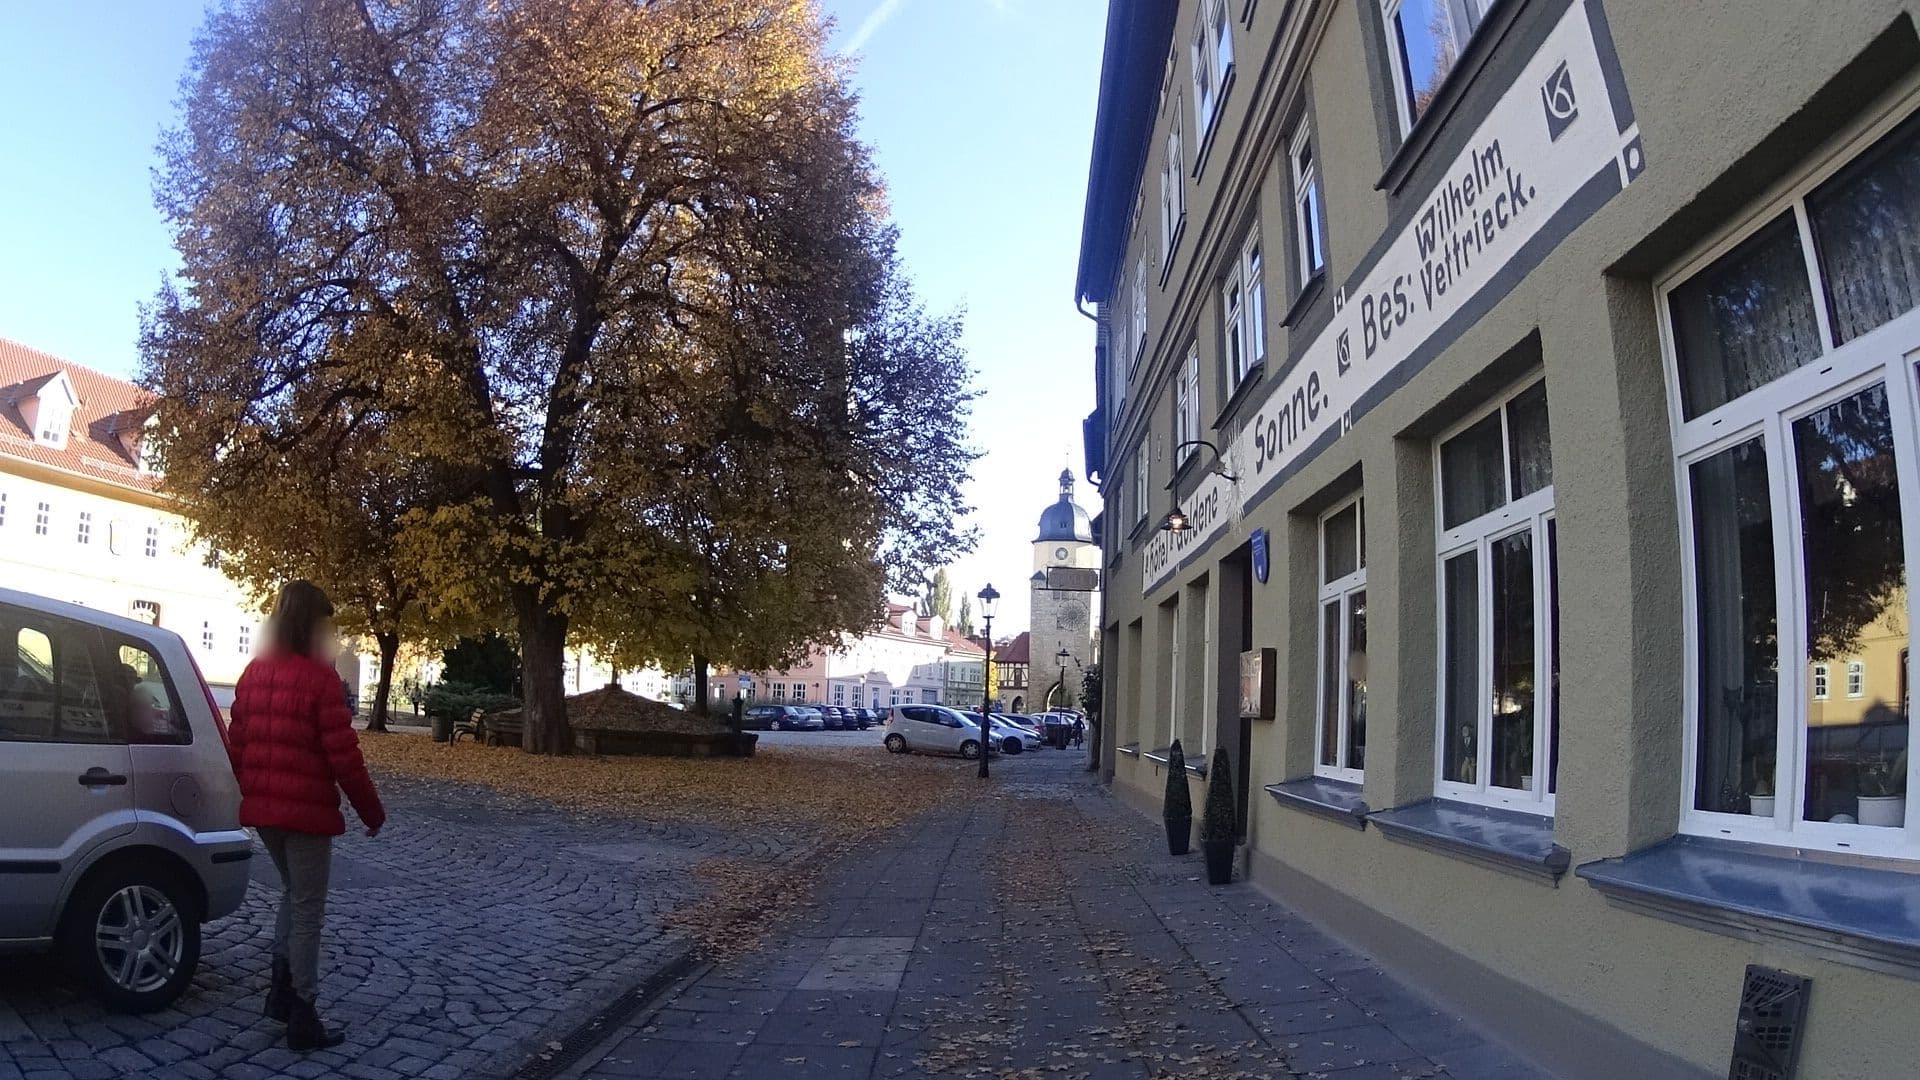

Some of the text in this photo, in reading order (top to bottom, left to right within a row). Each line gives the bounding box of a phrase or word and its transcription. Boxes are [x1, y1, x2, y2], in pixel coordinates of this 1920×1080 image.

[1415, 138, 1503, 261] Wilhelm
[1420, 167, 1535, 311] Vettrieck.
[1255, 371, 1328, 475] Sonne.
[1361, 274, 1415, 360] Bes:
